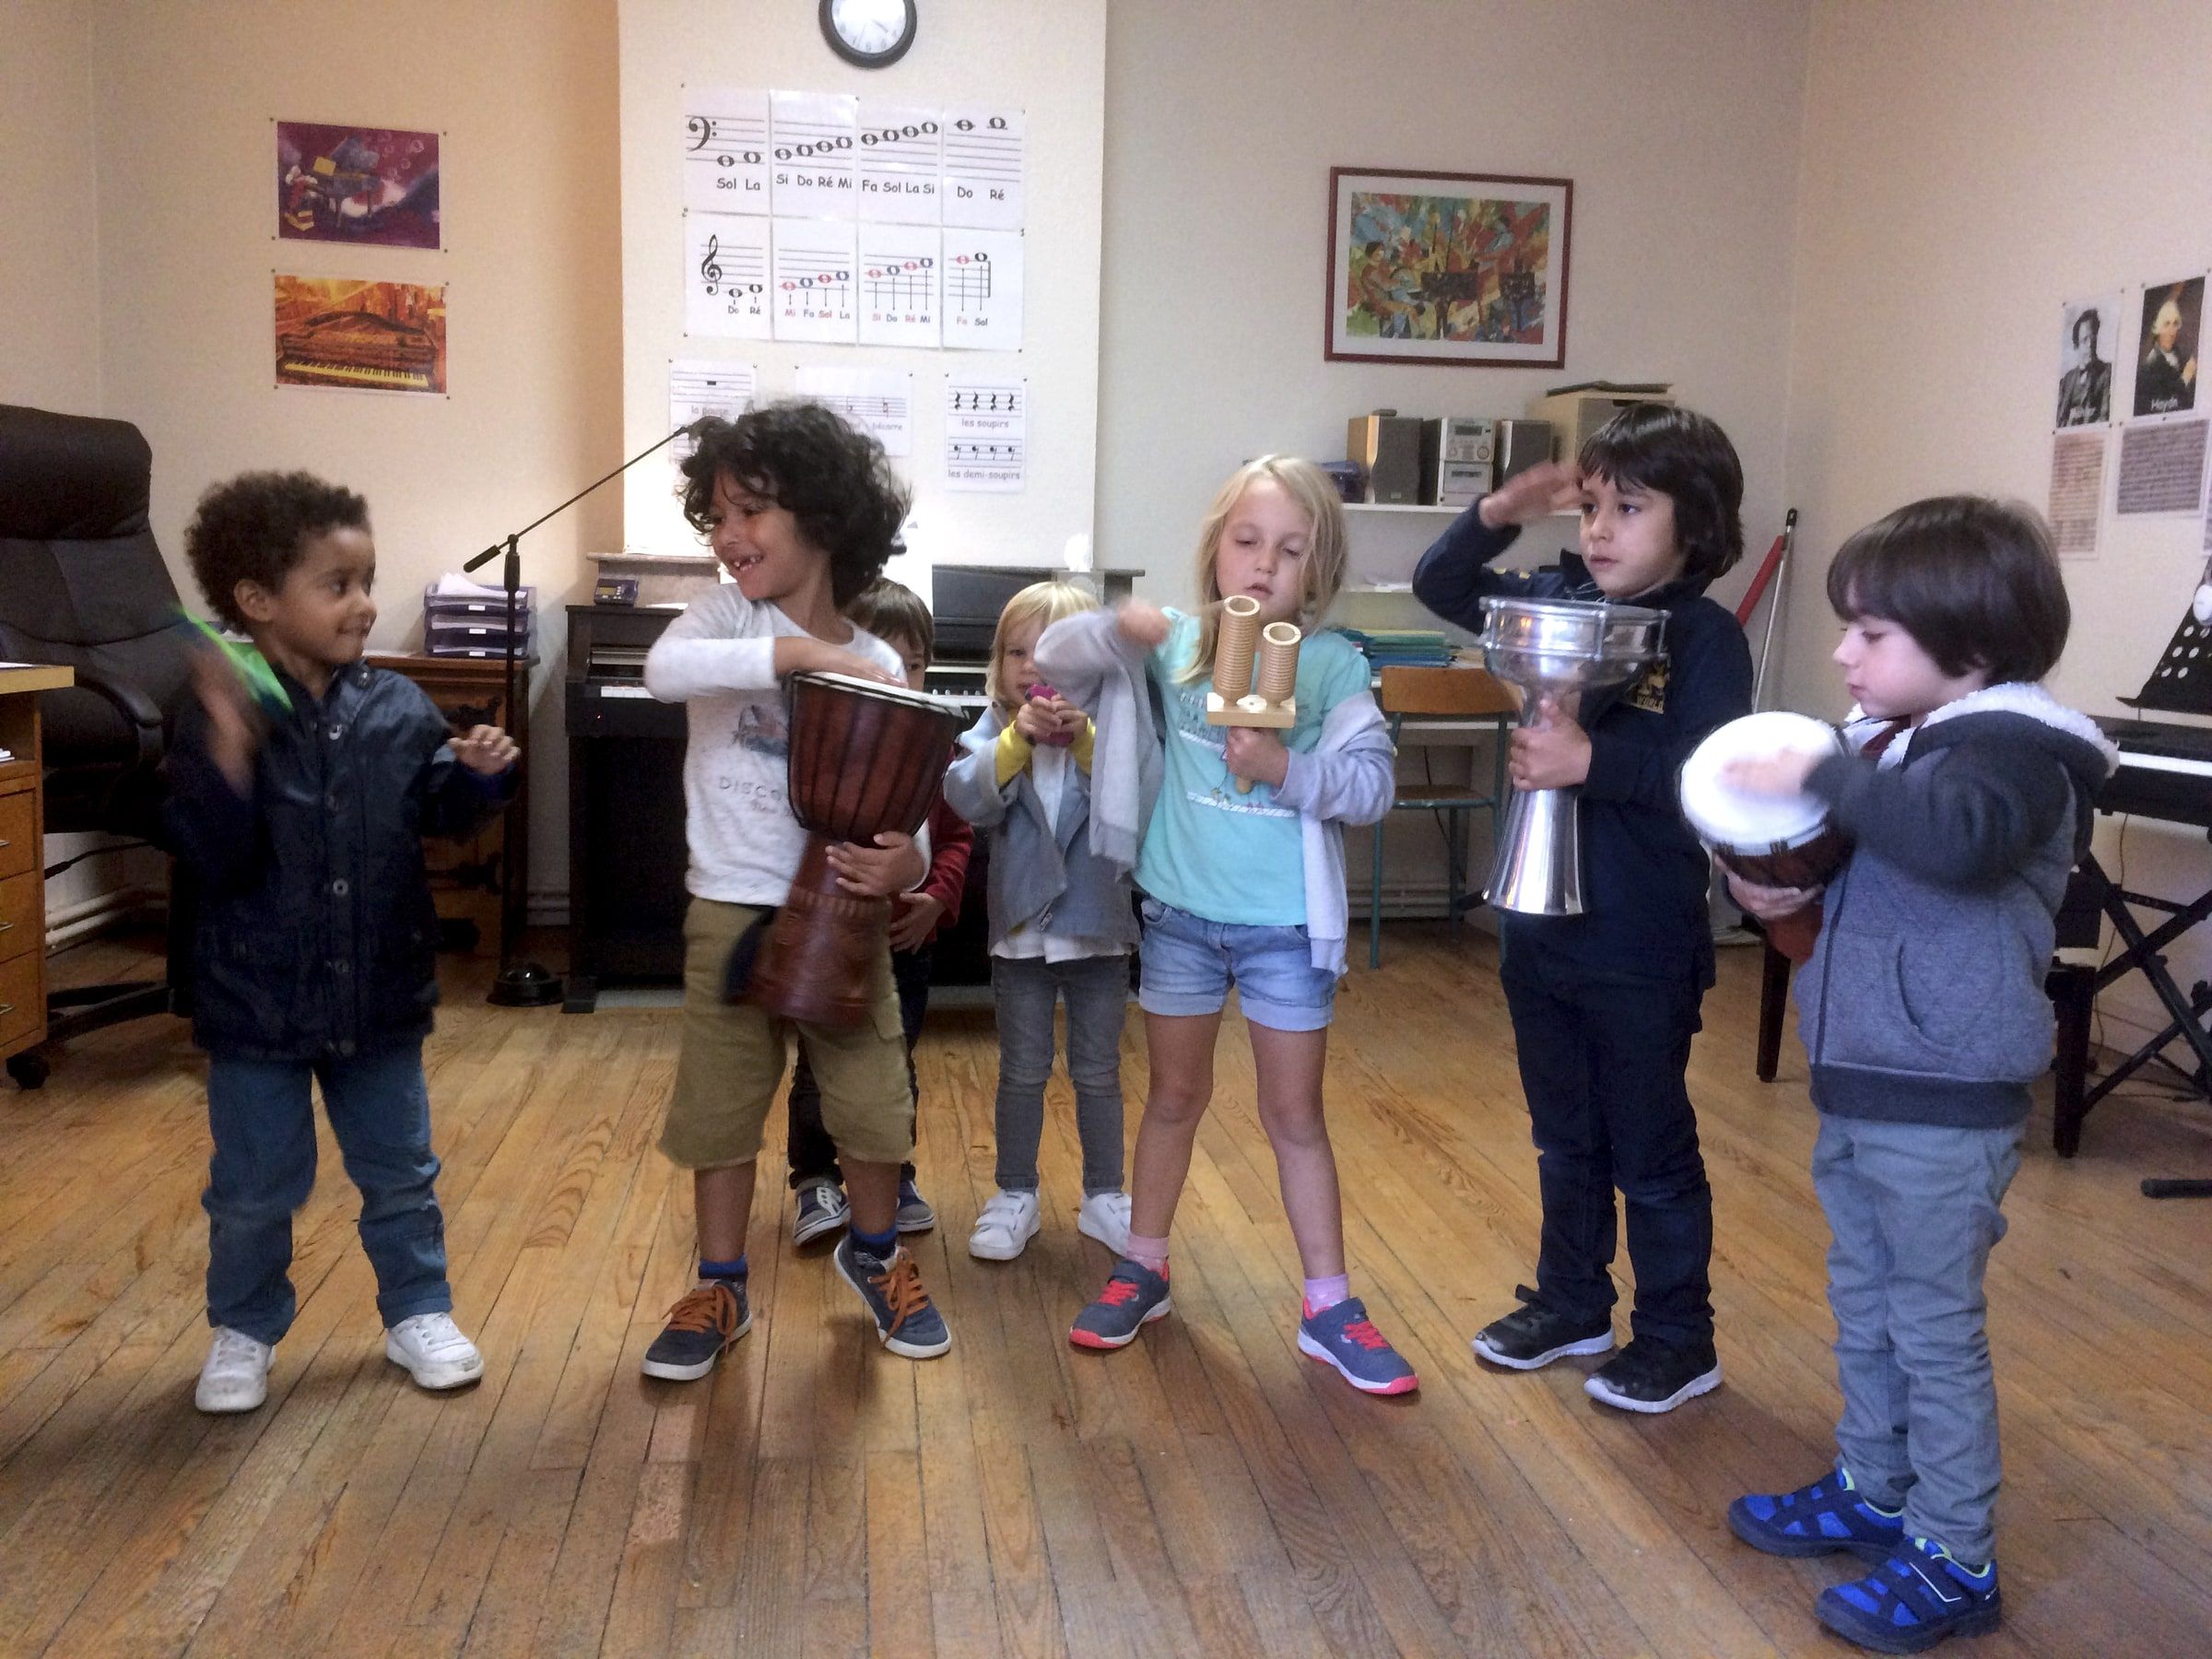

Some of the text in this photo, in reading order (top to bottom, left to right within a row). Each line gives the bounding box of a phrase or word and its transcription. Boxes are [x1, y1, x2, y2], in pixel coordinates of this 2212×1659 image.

[716, 177, 761, 191] Sol La
[775, 173, 853, 189] Si Do Ré Mi
[862, 179, 935, 194] Fa Sol La Si
[957, 185, 1006, 201] Do Ré
[727, 305, 761, 315] Do Ré
[784, 308, 851, 320] Mi Fa Sol La
[886, 313, 899, 323] Do
[920, 314, 931, 324] Mi
[974, 317, 988, 326] Sol
[961, 418, 1009, 429] les soupirs
[947, 468, 961, 478] les
